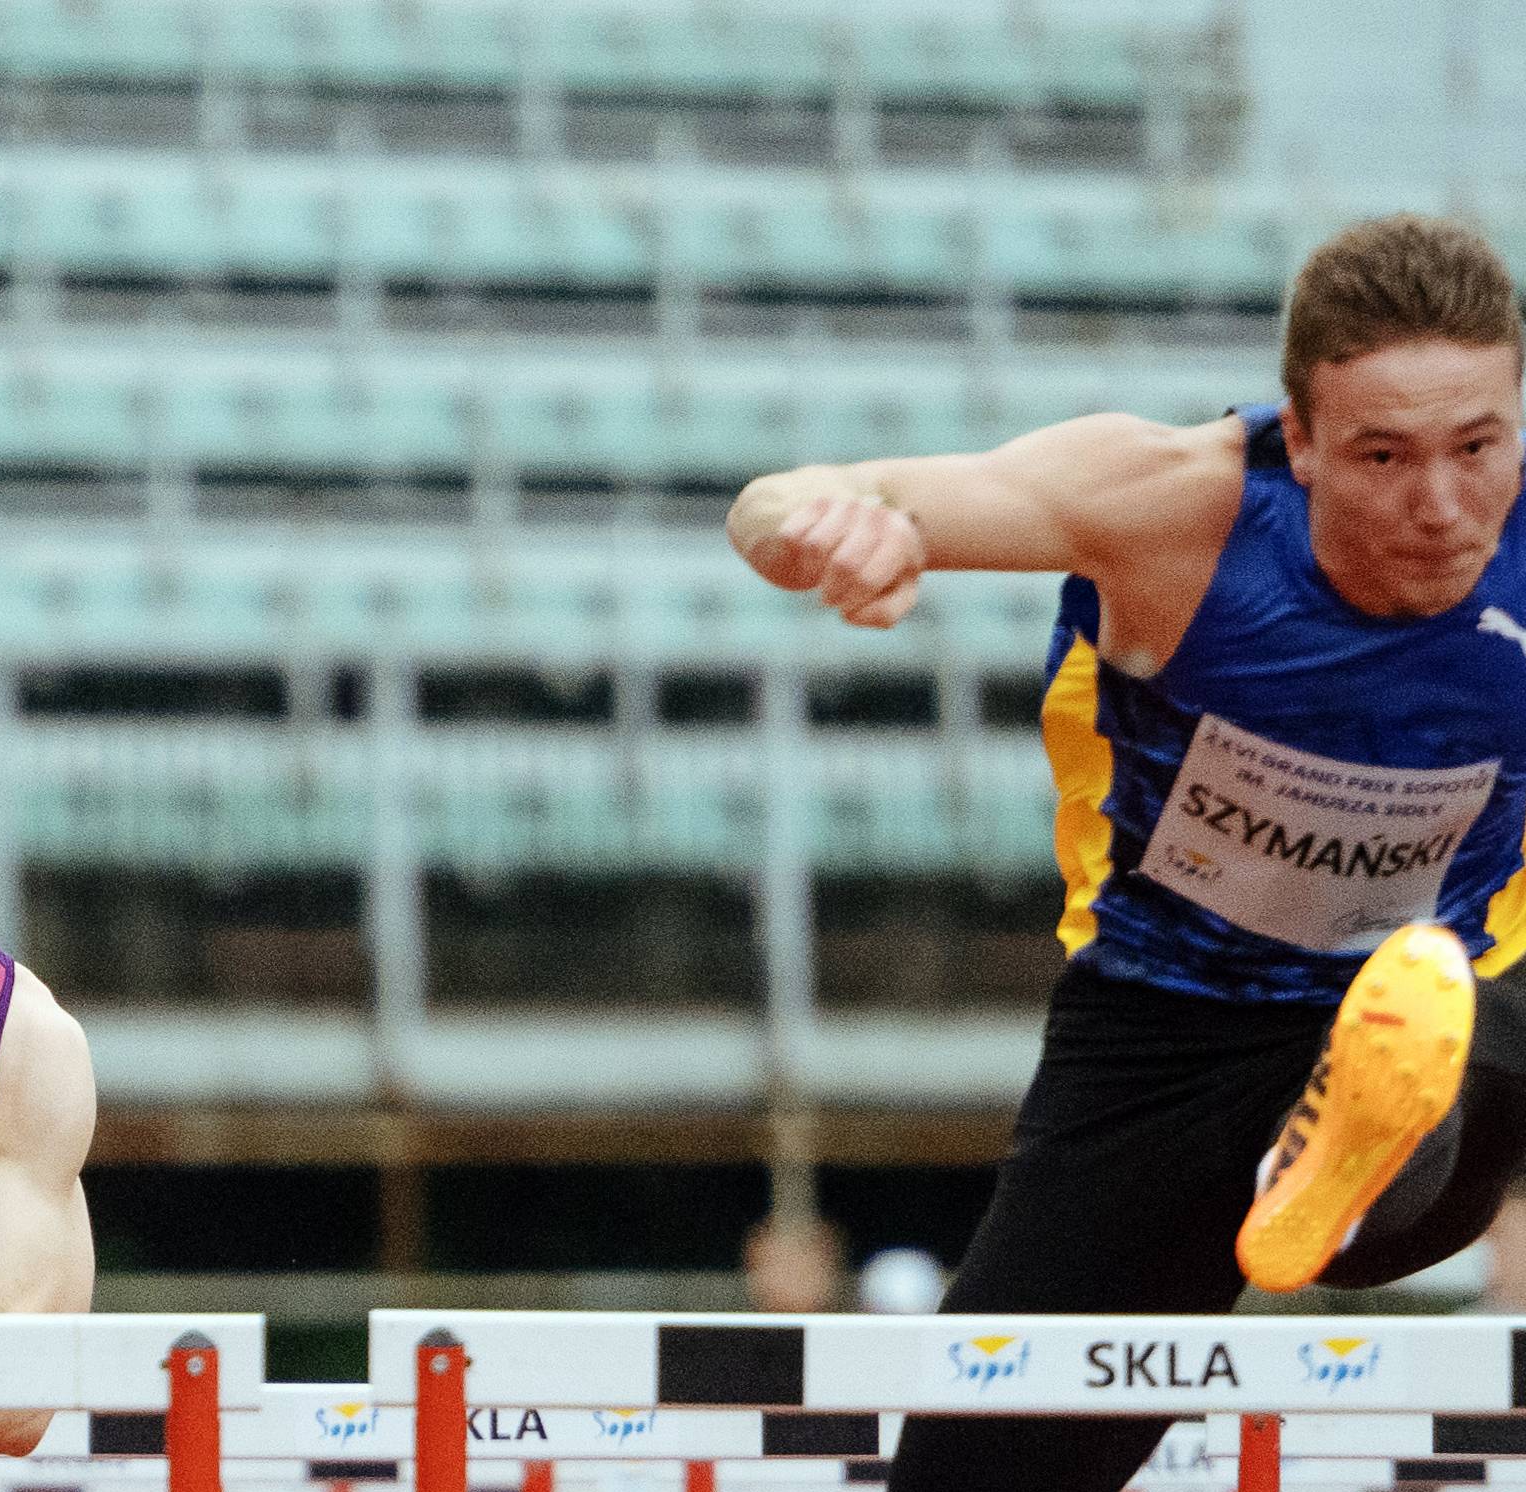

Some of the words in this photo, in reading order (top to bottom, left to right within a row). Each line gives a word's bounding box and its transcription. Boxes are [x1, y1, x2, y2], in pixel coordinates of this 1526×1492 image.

[1180, 783, 1455, 878] SZYMAŃSKI
[948, 1340, 1032, 1393] Sopot
[1085, 1341, 1241, 1389] SKLA
[1297, 1342, 1382, 1394] Sopot
[466, 1408, 549, 1441] KLA
